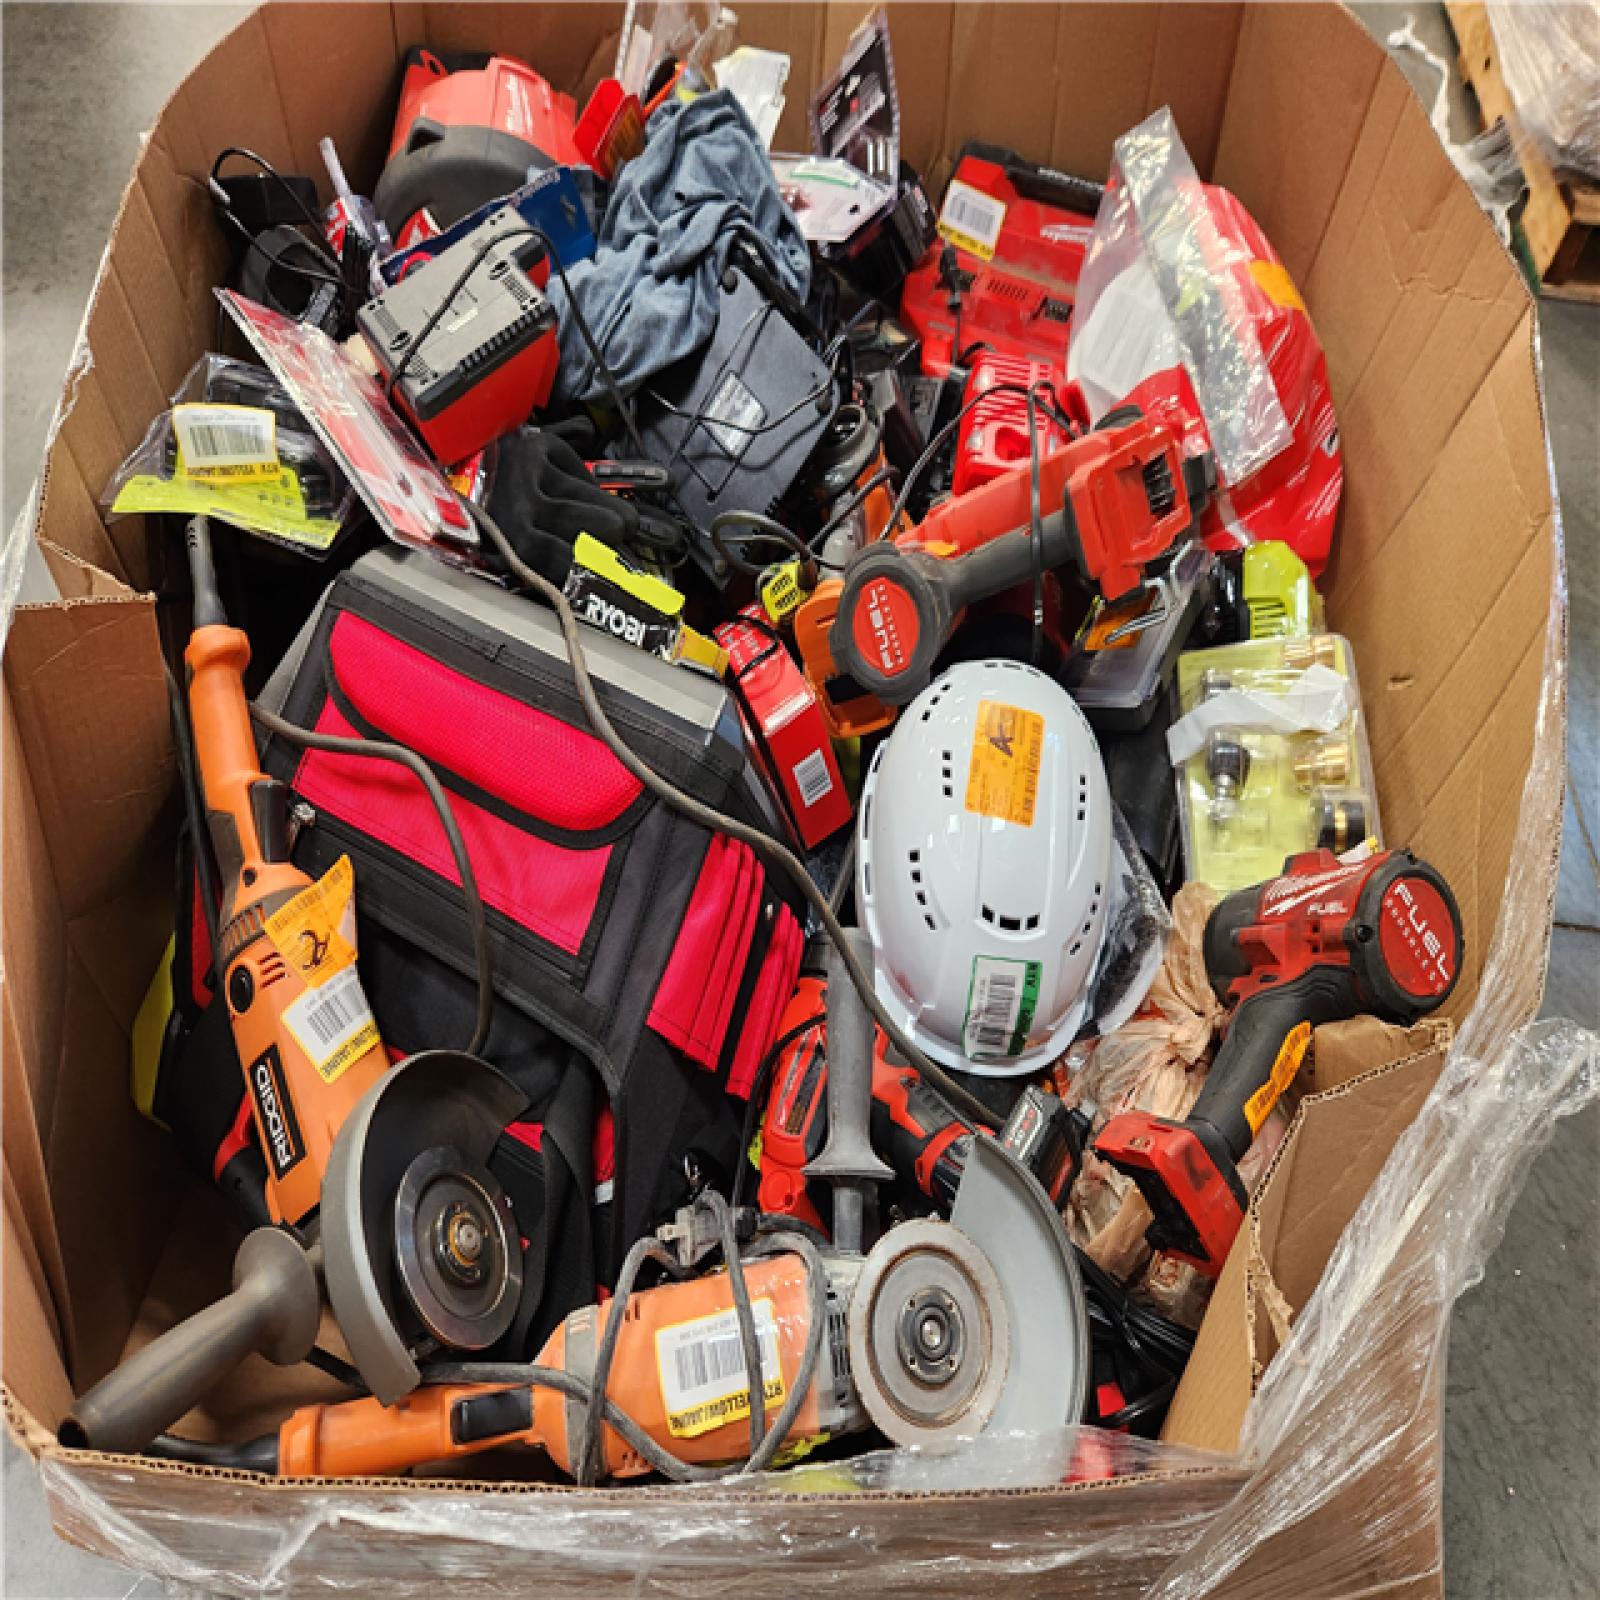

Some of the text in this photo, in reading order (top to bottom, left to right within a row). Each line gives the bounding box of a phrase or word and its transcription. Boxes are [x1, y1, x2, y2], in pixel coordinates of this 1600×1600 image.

[586, 592, 646, 646] RYOBI
[1307, 901, 1349, 916] FUEL
[1393, 882, 1450, 981] FUEL
[256, 1064, 291, 1168] RIDGID
